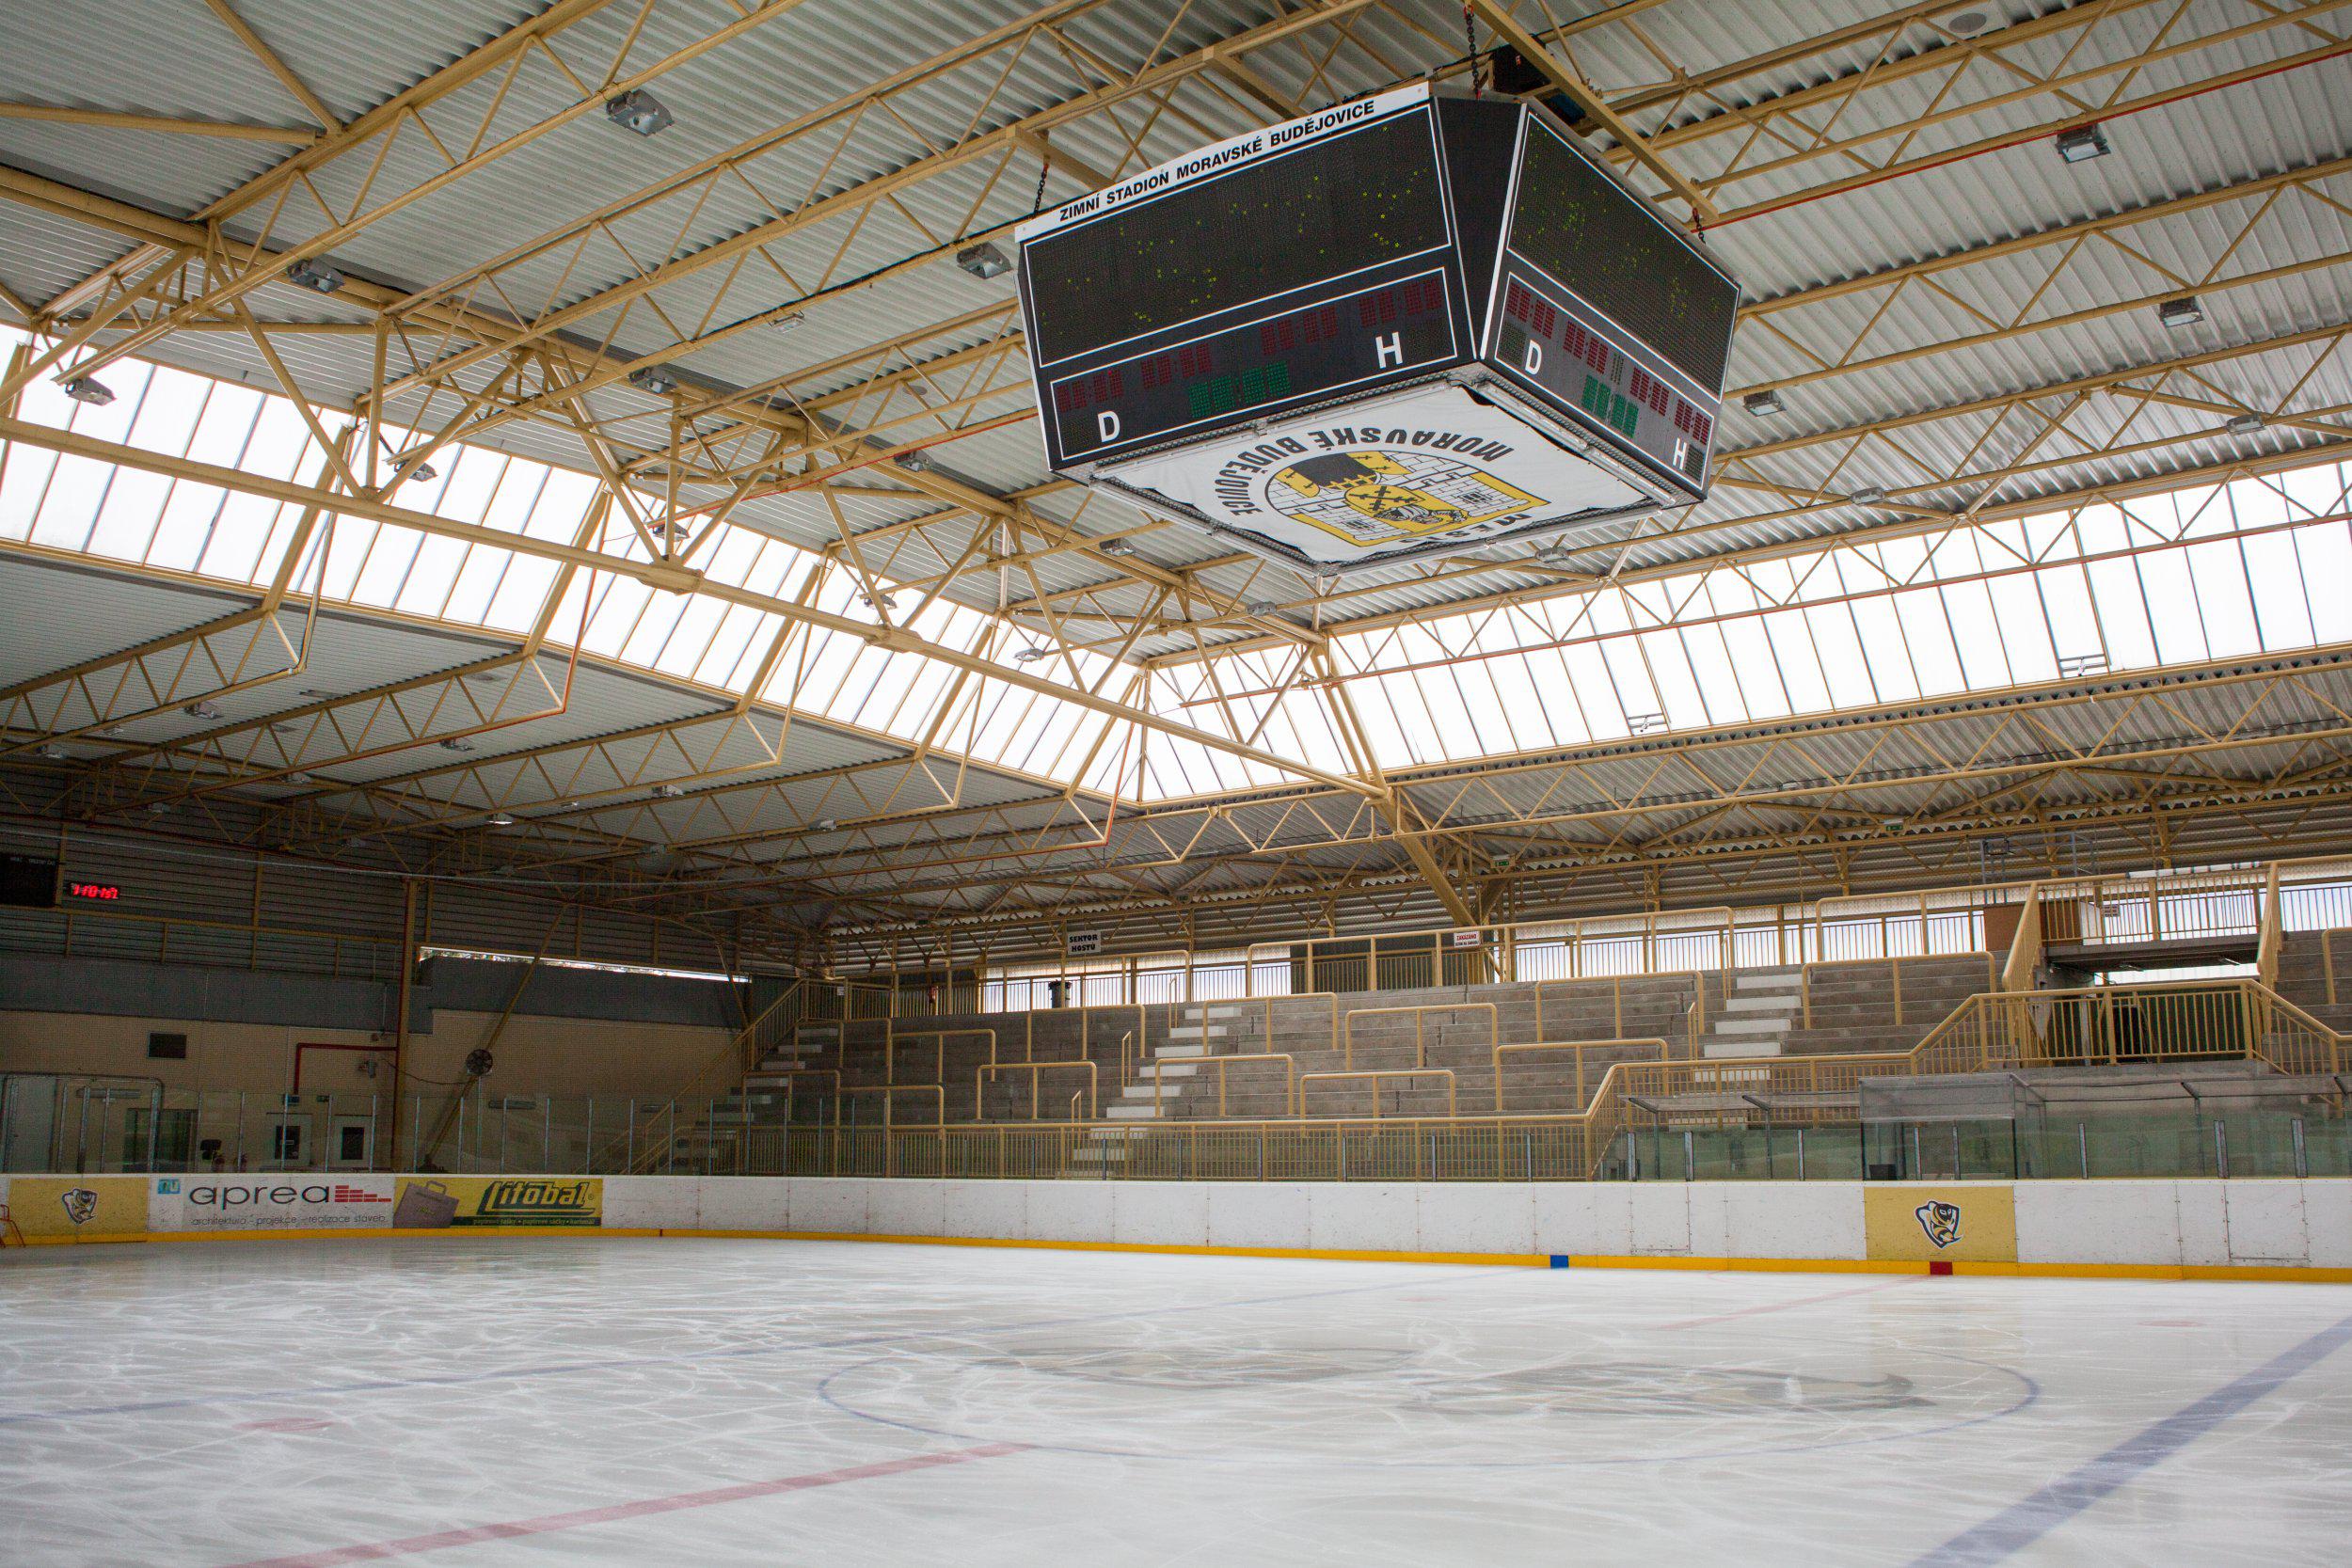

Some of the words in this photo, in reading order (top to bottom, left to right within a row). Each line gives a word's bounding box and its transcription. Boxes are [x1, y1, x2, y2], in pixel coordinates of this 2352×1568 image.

[1059, 194, 1100, 221] ZIMNÍ
[1106, 172, 1168, 204] STADION
[1176, 136, 1263, 180] MORAVSKÉ
[1270, 100, 1375, 147] BUDĚJOVICE
[1375, 331, 1403, 368] H
[1524, 340, 1542, 375] D
[1097, 410, 1120, 442] D
[1307, 427, 1515, 463] MORAVSKÉ
[1673, 437, 1687, 470] H
[1214, 436, 1310, 516] BUDĚJOVICE
[1069, 934, 1098, 942] SEKTOR
[189, 1185, 330, 1210] aprea
[477, 1181, 595, 1215] Litobal
[309, 1213, 350, 1223] realizace
[354, 1213, 386, 1223] staveb
